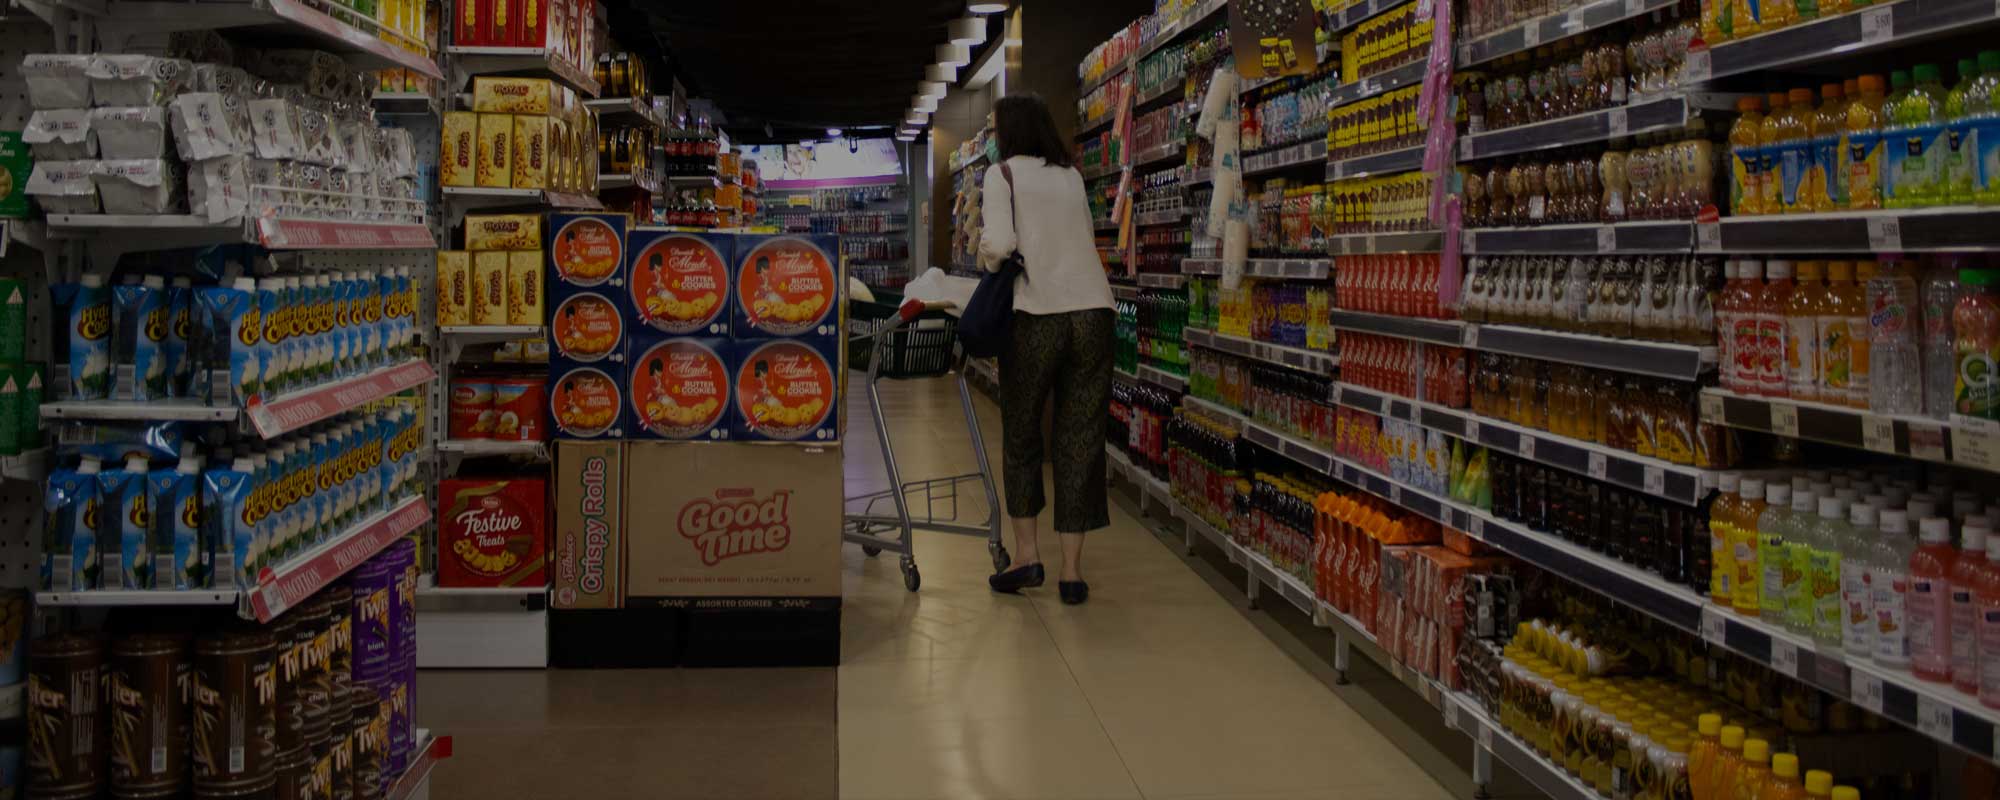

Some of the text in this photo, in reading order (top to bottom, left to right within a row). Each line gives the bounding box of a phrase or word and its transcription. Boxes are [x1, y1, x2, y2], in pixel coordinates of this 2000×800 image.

[495, 85, 528, 96] ROYAL
[484, 222, 520, 232] ROYAL
[681, 282, 716, 290] COOKIES
[788, 284, 823, 292] COOKIES
[681, 388, 717, 396] COOKIES
[787, 388, 822, 396] COOKIES
[678, 489, 789, 538] Good
[456, 508, 522, 536] Festive
[580, 458, 609, 592] Crispy Rolls
[476, 534, 505, 548] Treats
[694, 523, 790, 566] Time
[696, 599, 772, 608] ASSORTED COOKIES
